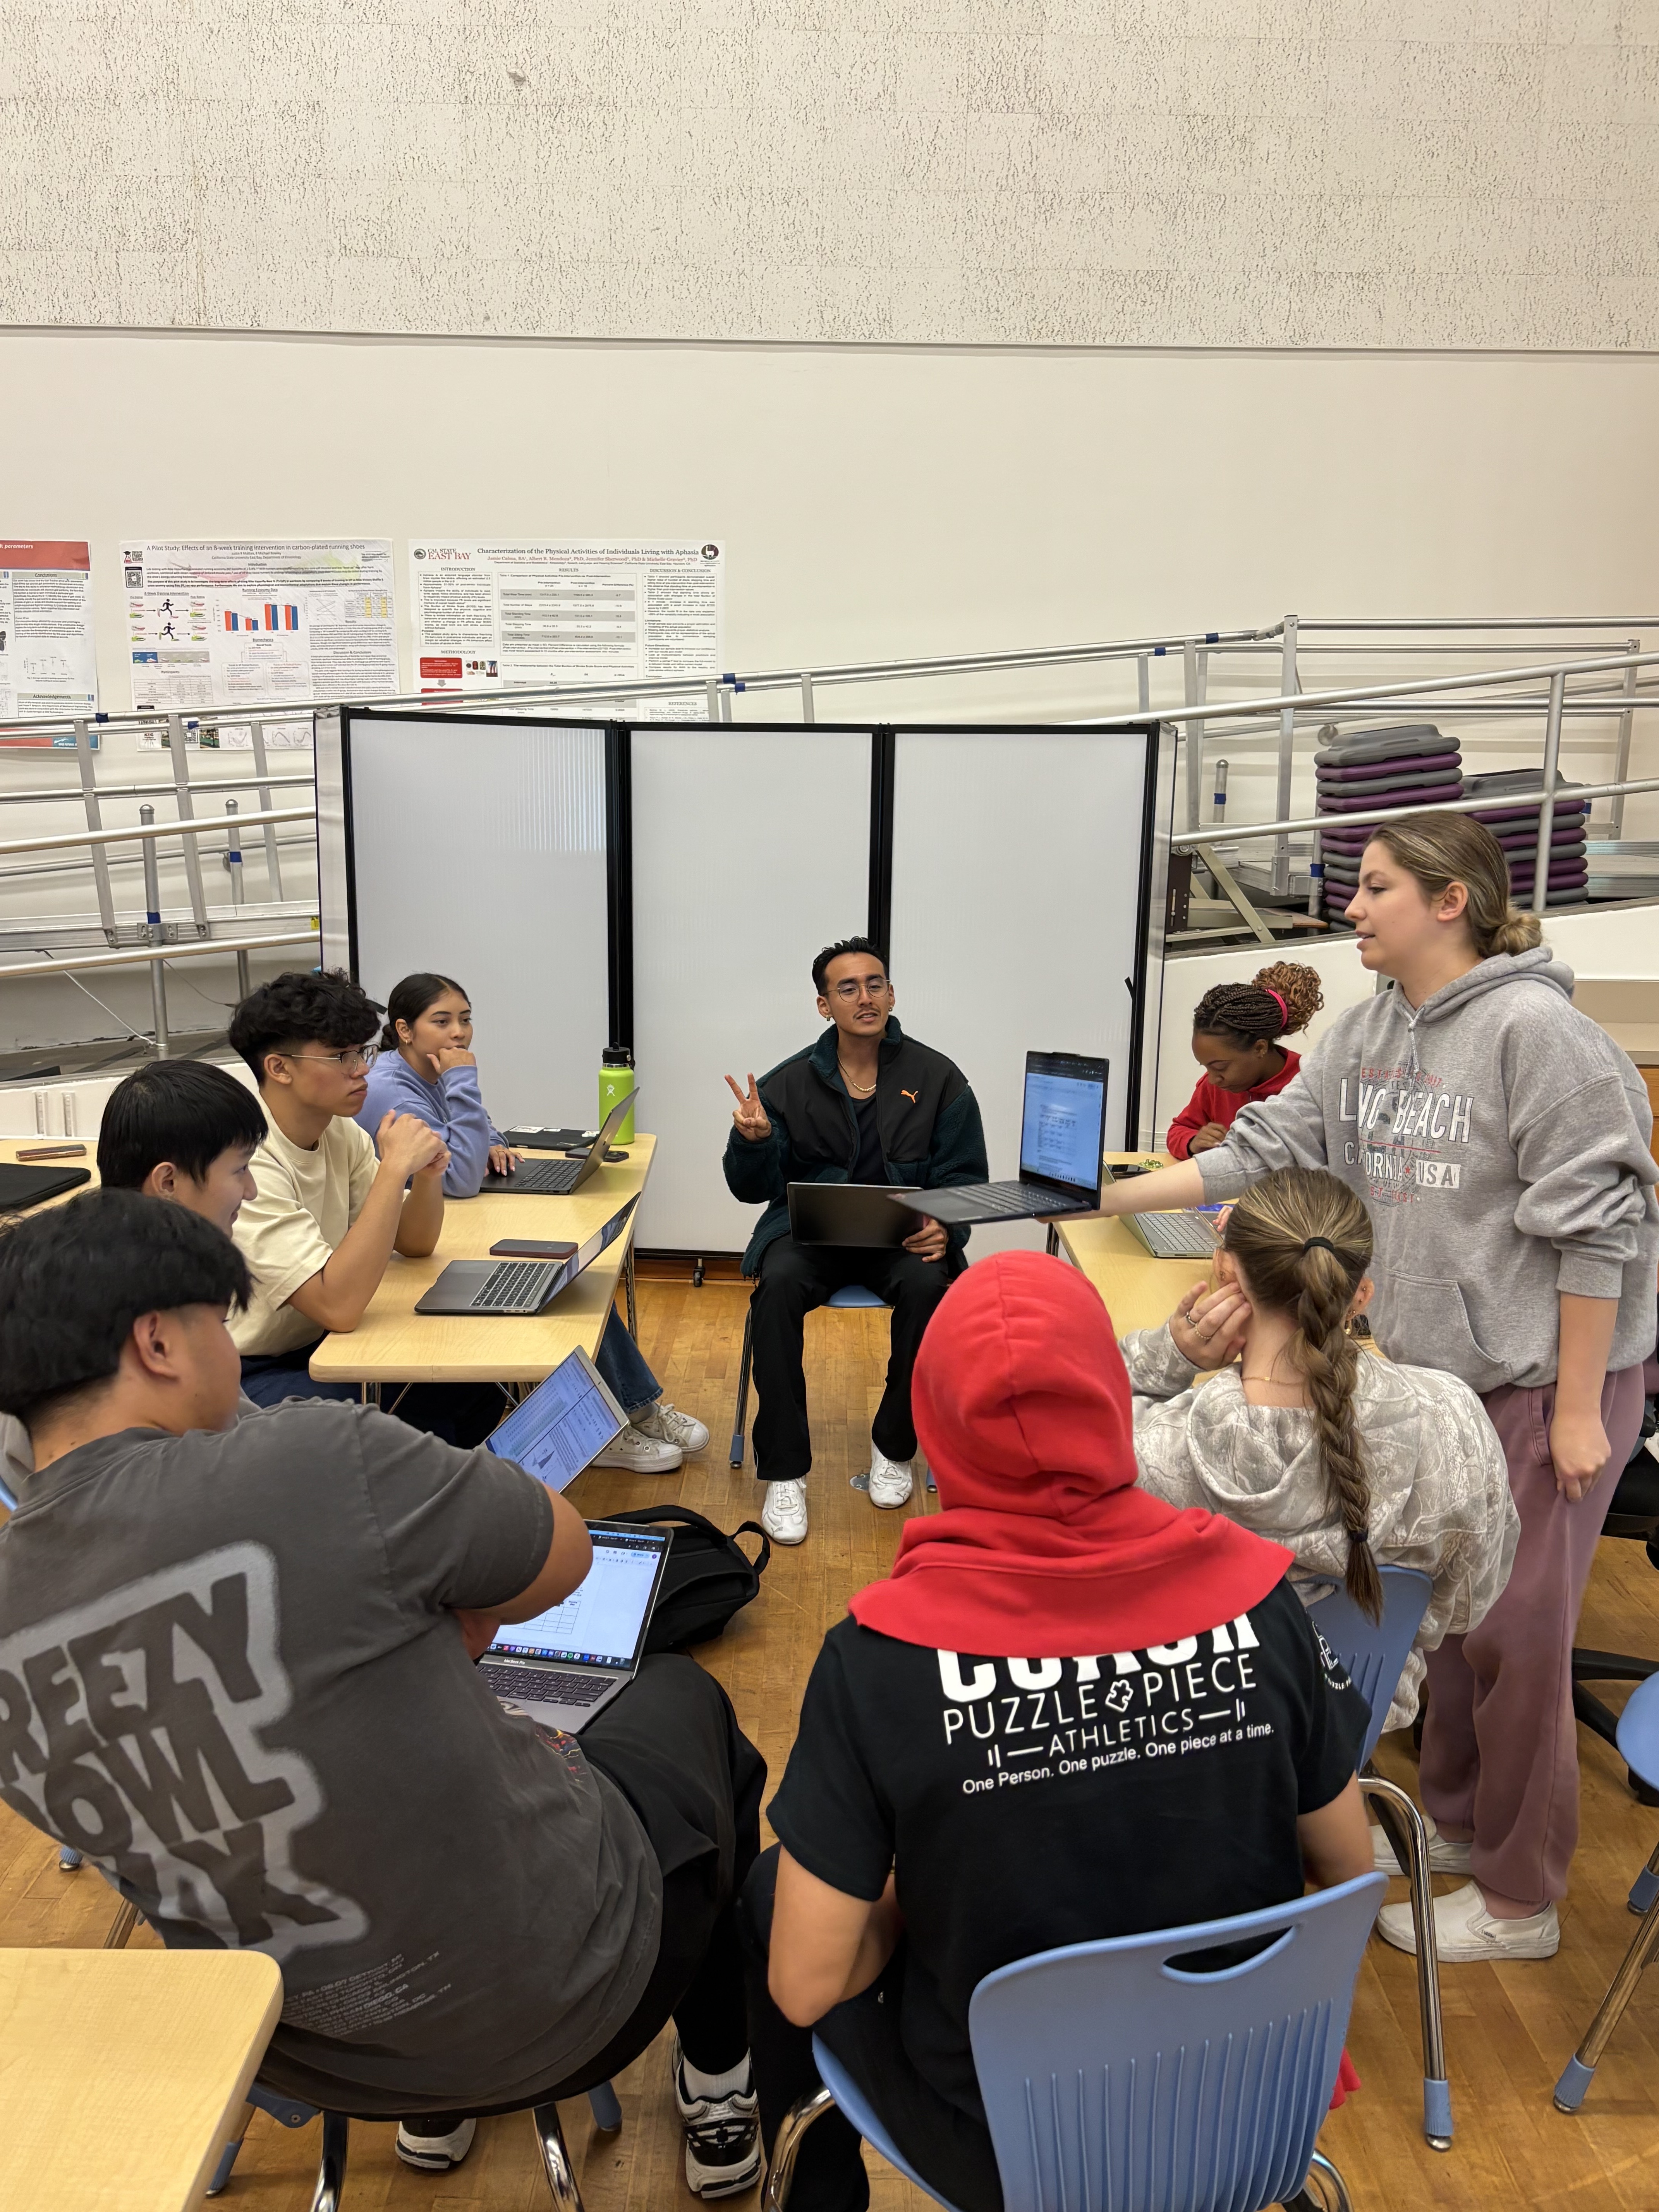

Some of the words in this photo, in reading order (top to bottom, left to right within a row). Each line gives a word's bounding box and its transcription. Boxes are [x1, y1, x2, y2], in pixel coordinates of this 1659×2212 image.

[1392, 1089, 1474, 1143] BEACH
[1418, 1161, 1454, 1186] USA
[943, 1683, 1098, 1746] PUZZLE
[1142, 1653, 1257, 1707] PIECE
[962, 1776, 994, 1795] One
[999, 1767, 1054, 1787] Person.
[1059, 1757, 1088, 1776] One
[1091, 1746, 1141, 1772] puzzle.
[1145, 1741, 1177, 1759] One
[1180, 1736, 1216, 1756] piece
[1219, 1729, 1232, 1745] at
[1235, 1729, 1243, 1741] a
[1246, 1723, 1274, 1739] time.
[1048, 1708, 1195, 1758] ATHLETICS
[0, 1710, 295, 1856] OWL
